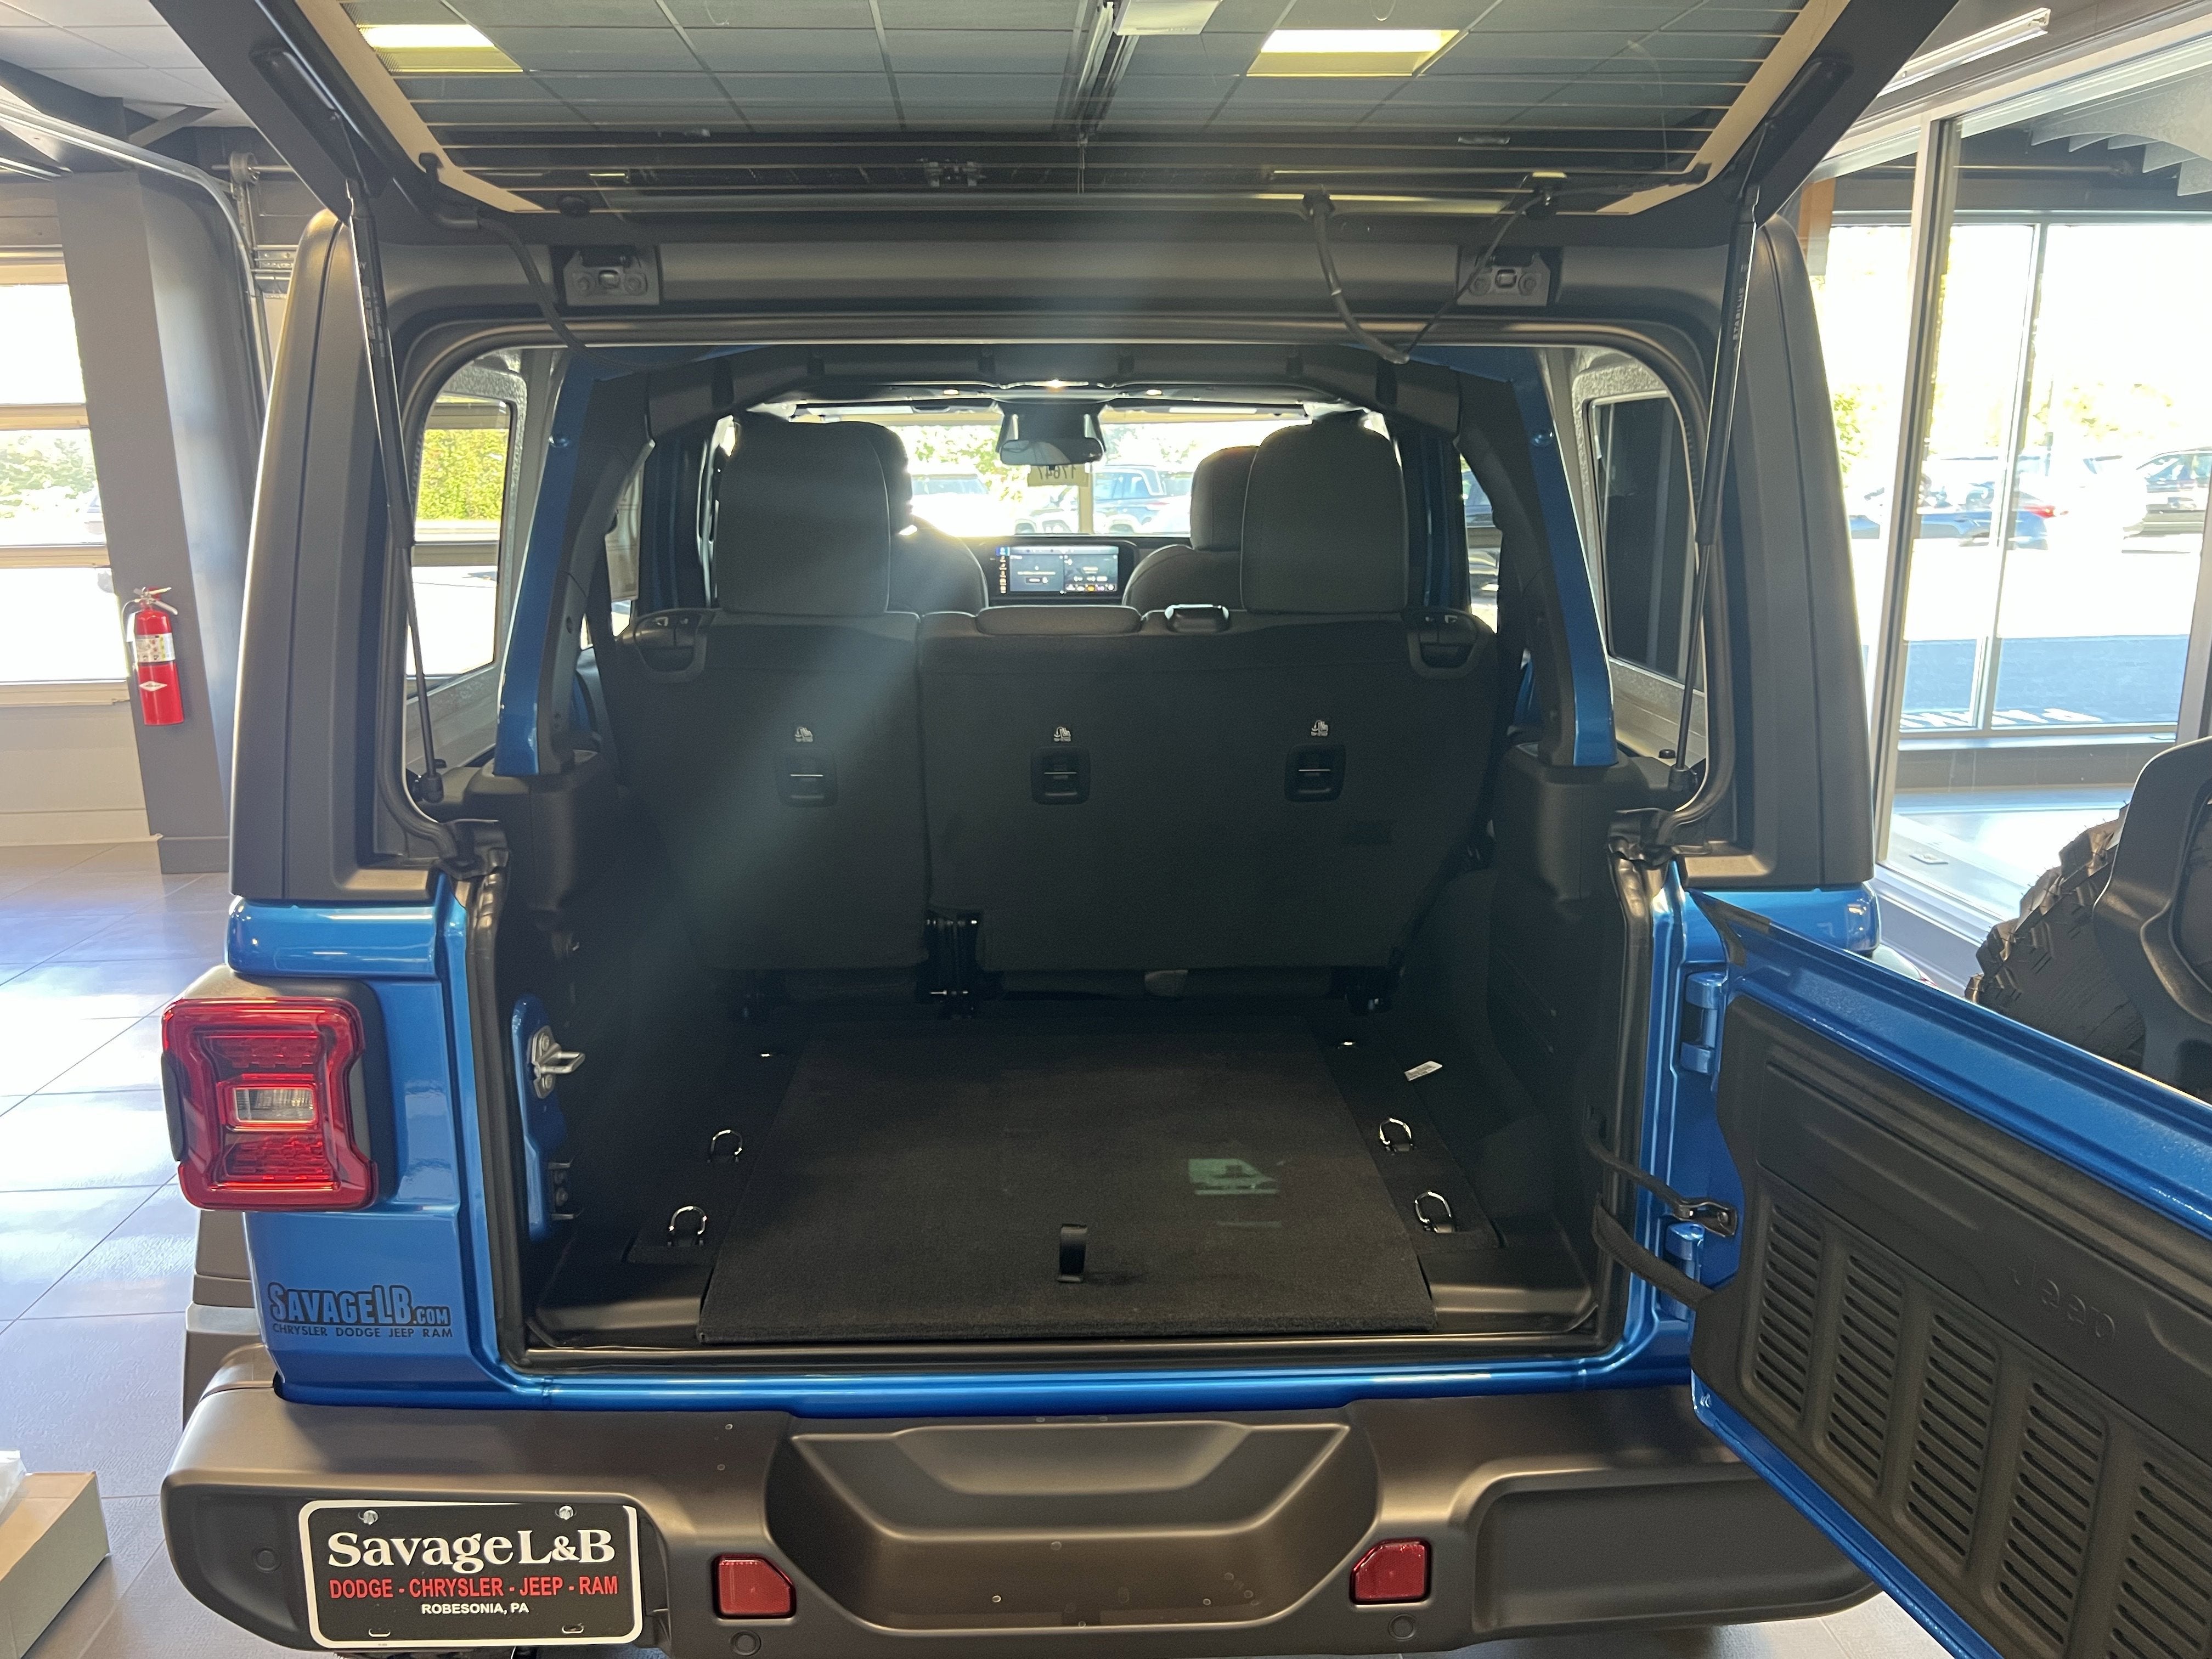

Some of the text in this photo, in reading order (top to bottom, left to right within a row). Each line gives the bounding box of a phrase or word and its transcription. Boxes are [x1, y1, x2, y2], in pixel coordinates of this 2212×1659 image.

[274, 1323, 453, 1338] CHRYSLER DODGE JEEP RAM
[330, 1578, 394, 1599] DODGE
[409, 1577, 504, 1598] CHRYSLER
[520, 1576, 563, 1596] JEEP
[579, 1576, 618, 1595] RAM
[421, 1602, 530, 1616] ROBESONIA, PA
